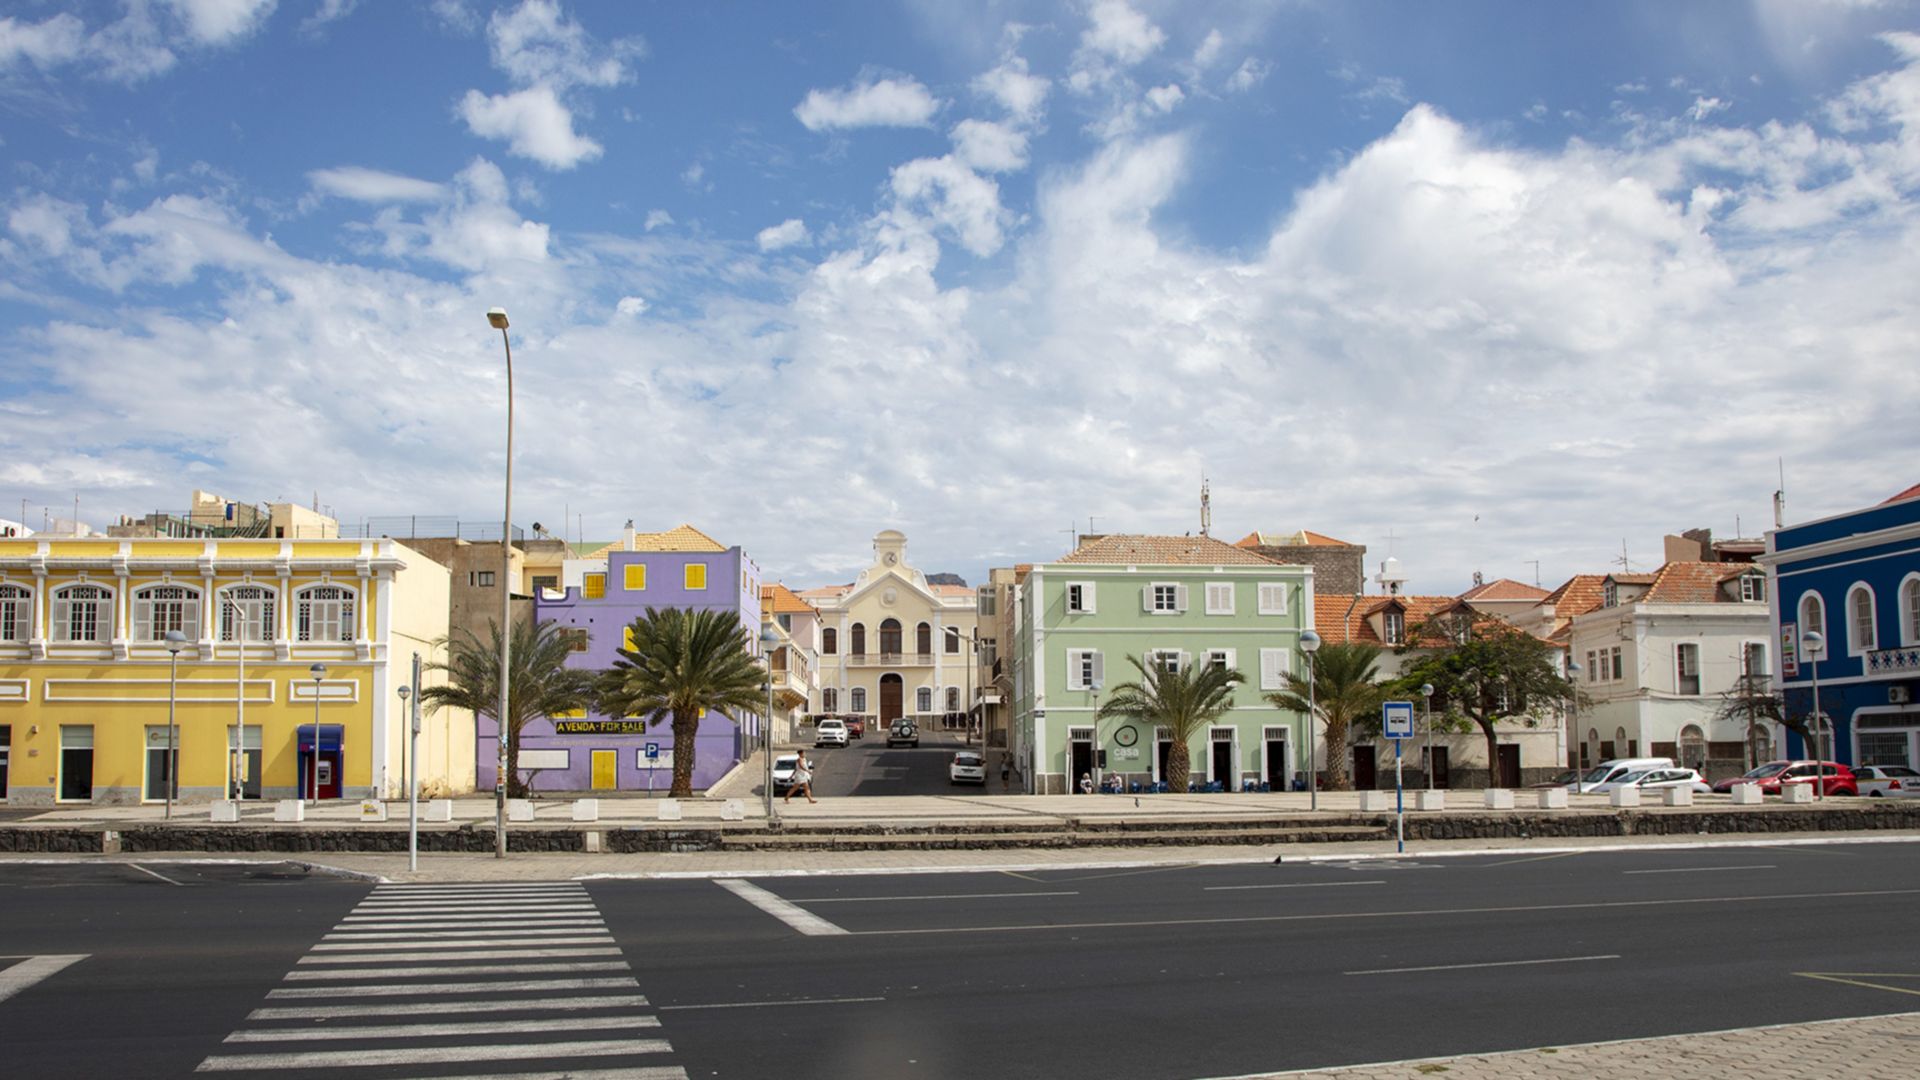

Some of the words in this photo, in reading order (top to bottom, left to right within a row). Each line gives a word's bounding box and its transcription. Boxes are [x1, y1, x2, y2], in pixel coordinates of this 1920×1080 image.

[600, 722, 620, 732] FOR
[621, 722, 644, 732] SALE
[647, 744, 657, 756] P
